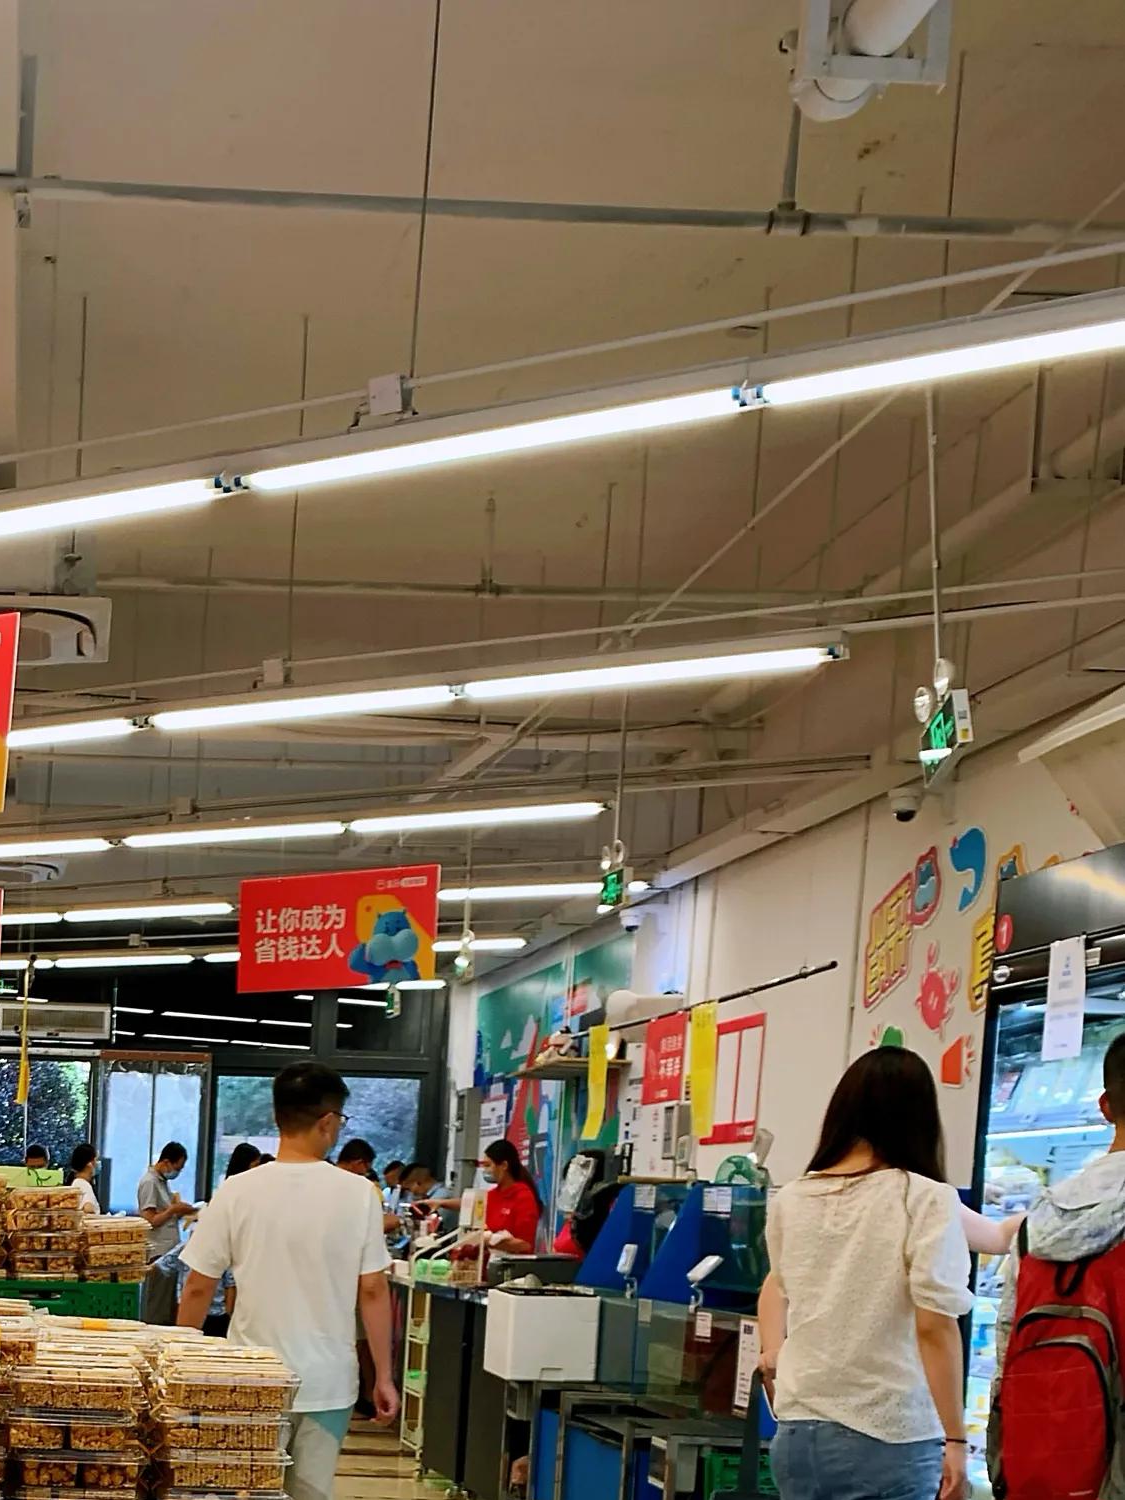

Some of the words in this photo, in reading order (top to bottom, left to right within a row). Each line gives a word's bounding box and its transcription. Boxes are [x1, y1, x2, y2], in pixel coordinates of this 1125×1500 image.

[255, 904, 347, 934] 让你成为
[255, 933, 345, 964] 省钱达人
